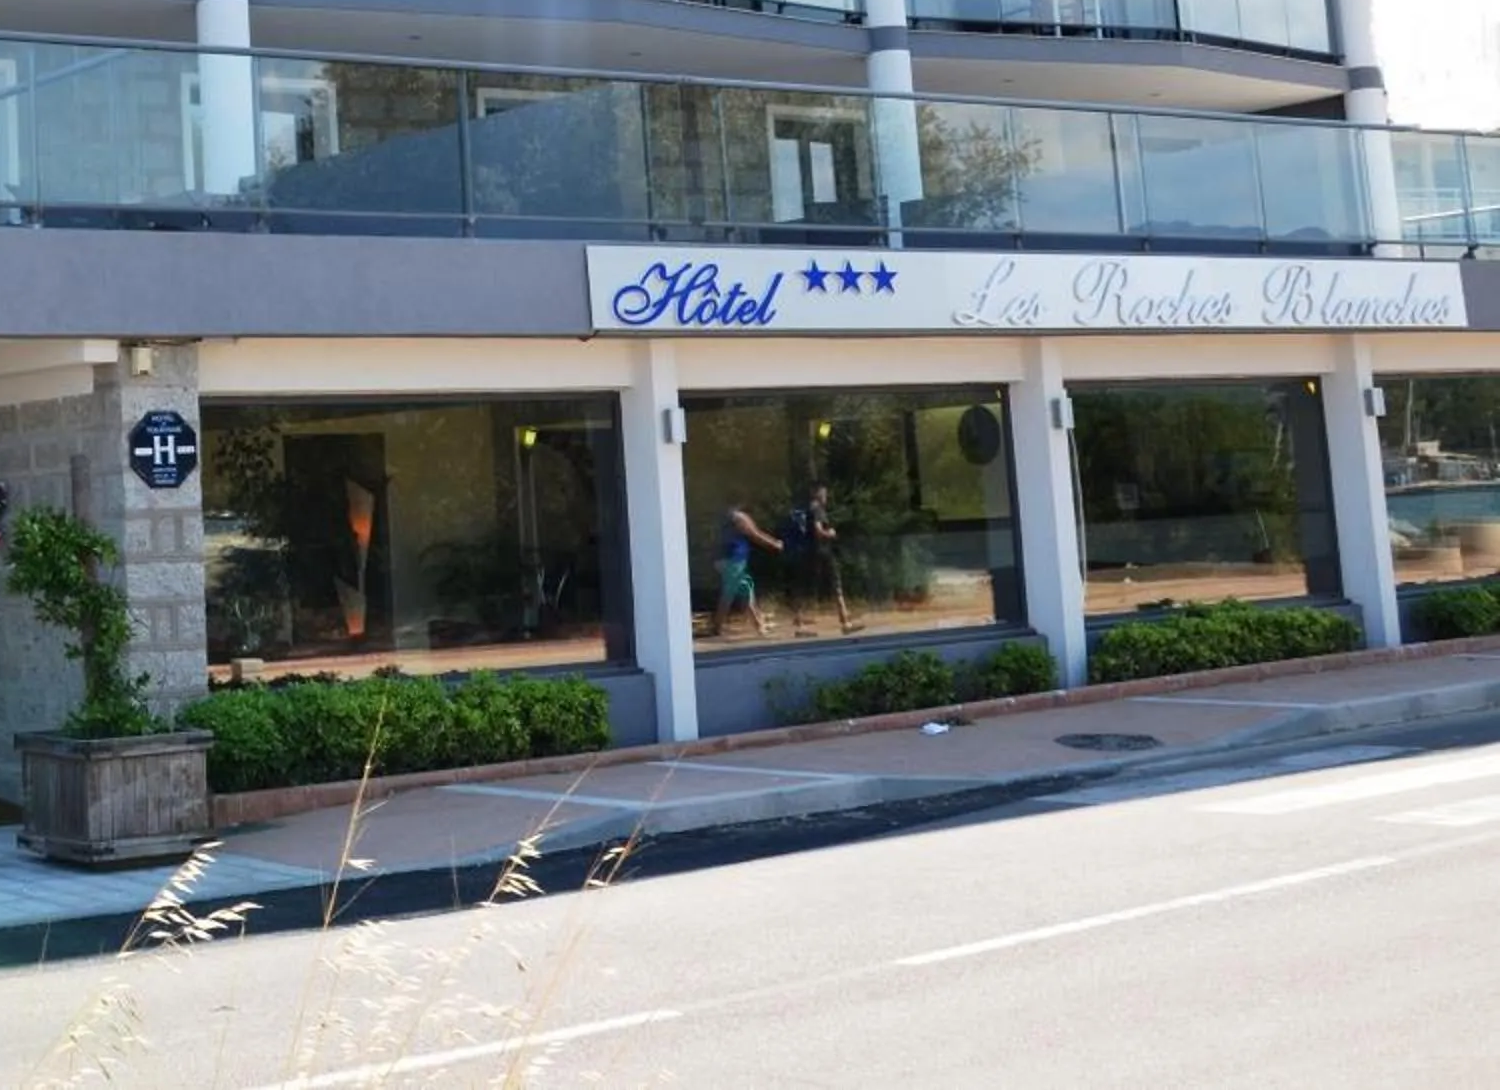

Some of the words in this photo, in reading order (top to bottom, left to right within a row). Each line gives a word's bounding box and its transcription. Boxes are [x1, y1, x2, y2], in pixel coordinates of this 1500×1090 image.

[613, 262, 784, 325] Hôtel
[951, 259, 1040, 326] Les
[1073, 258, 1232, 326] Roches
[1261, 261, 1450, 325] Blanches
[153, 435, 176, 465] H
